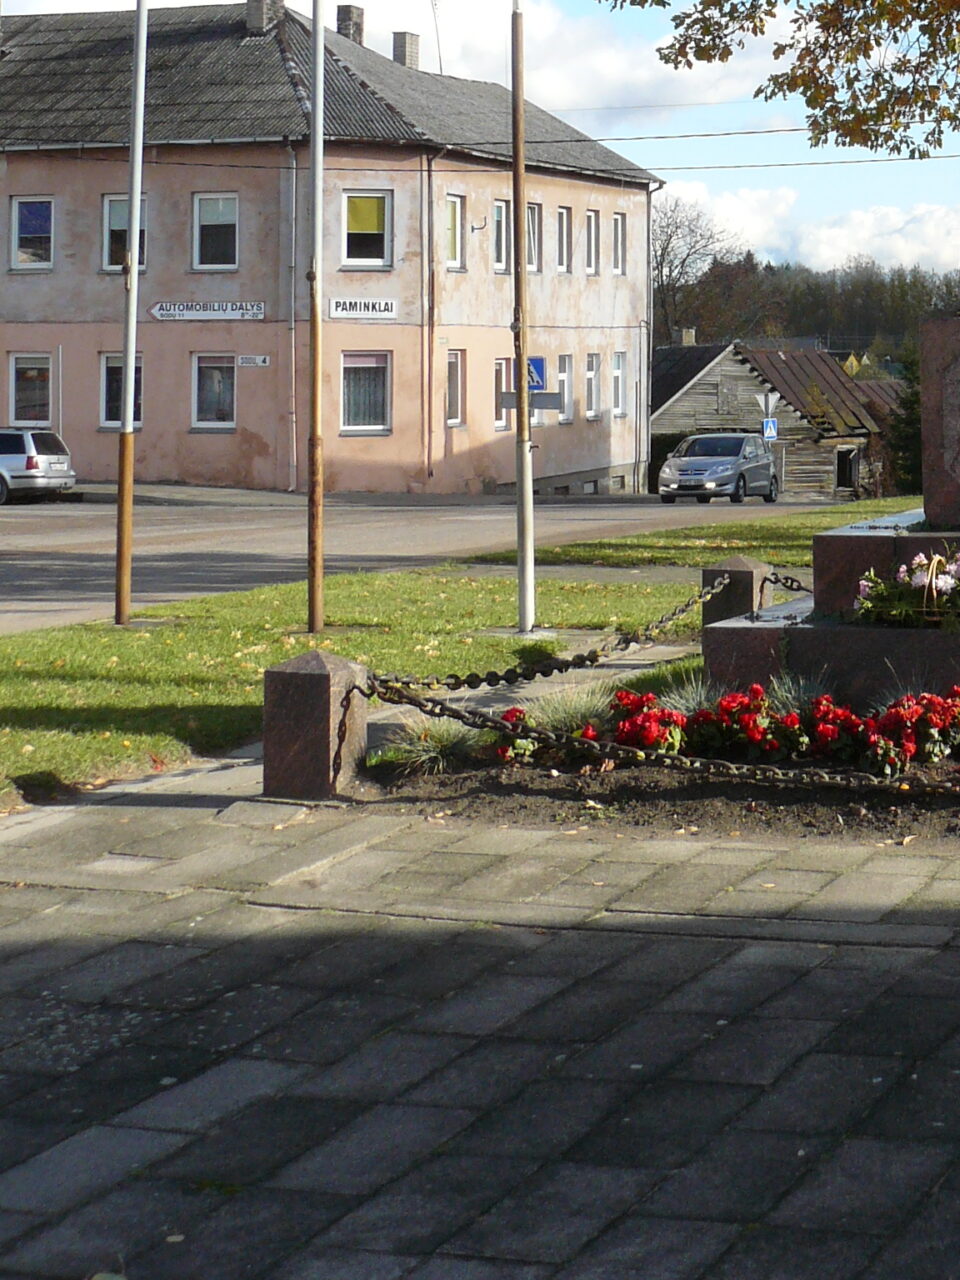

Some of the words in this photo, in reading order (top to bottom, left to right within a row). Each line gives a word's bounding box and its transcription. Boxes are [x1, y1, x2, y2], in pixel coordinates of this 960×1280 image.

[158, 303, 228, 314] AUTOMOBILIŲ
[231, 302, 263, 312] DALYS
[335, 301, 393, 313] PAMINKLAI
[261, 356, 267, 365] 4
